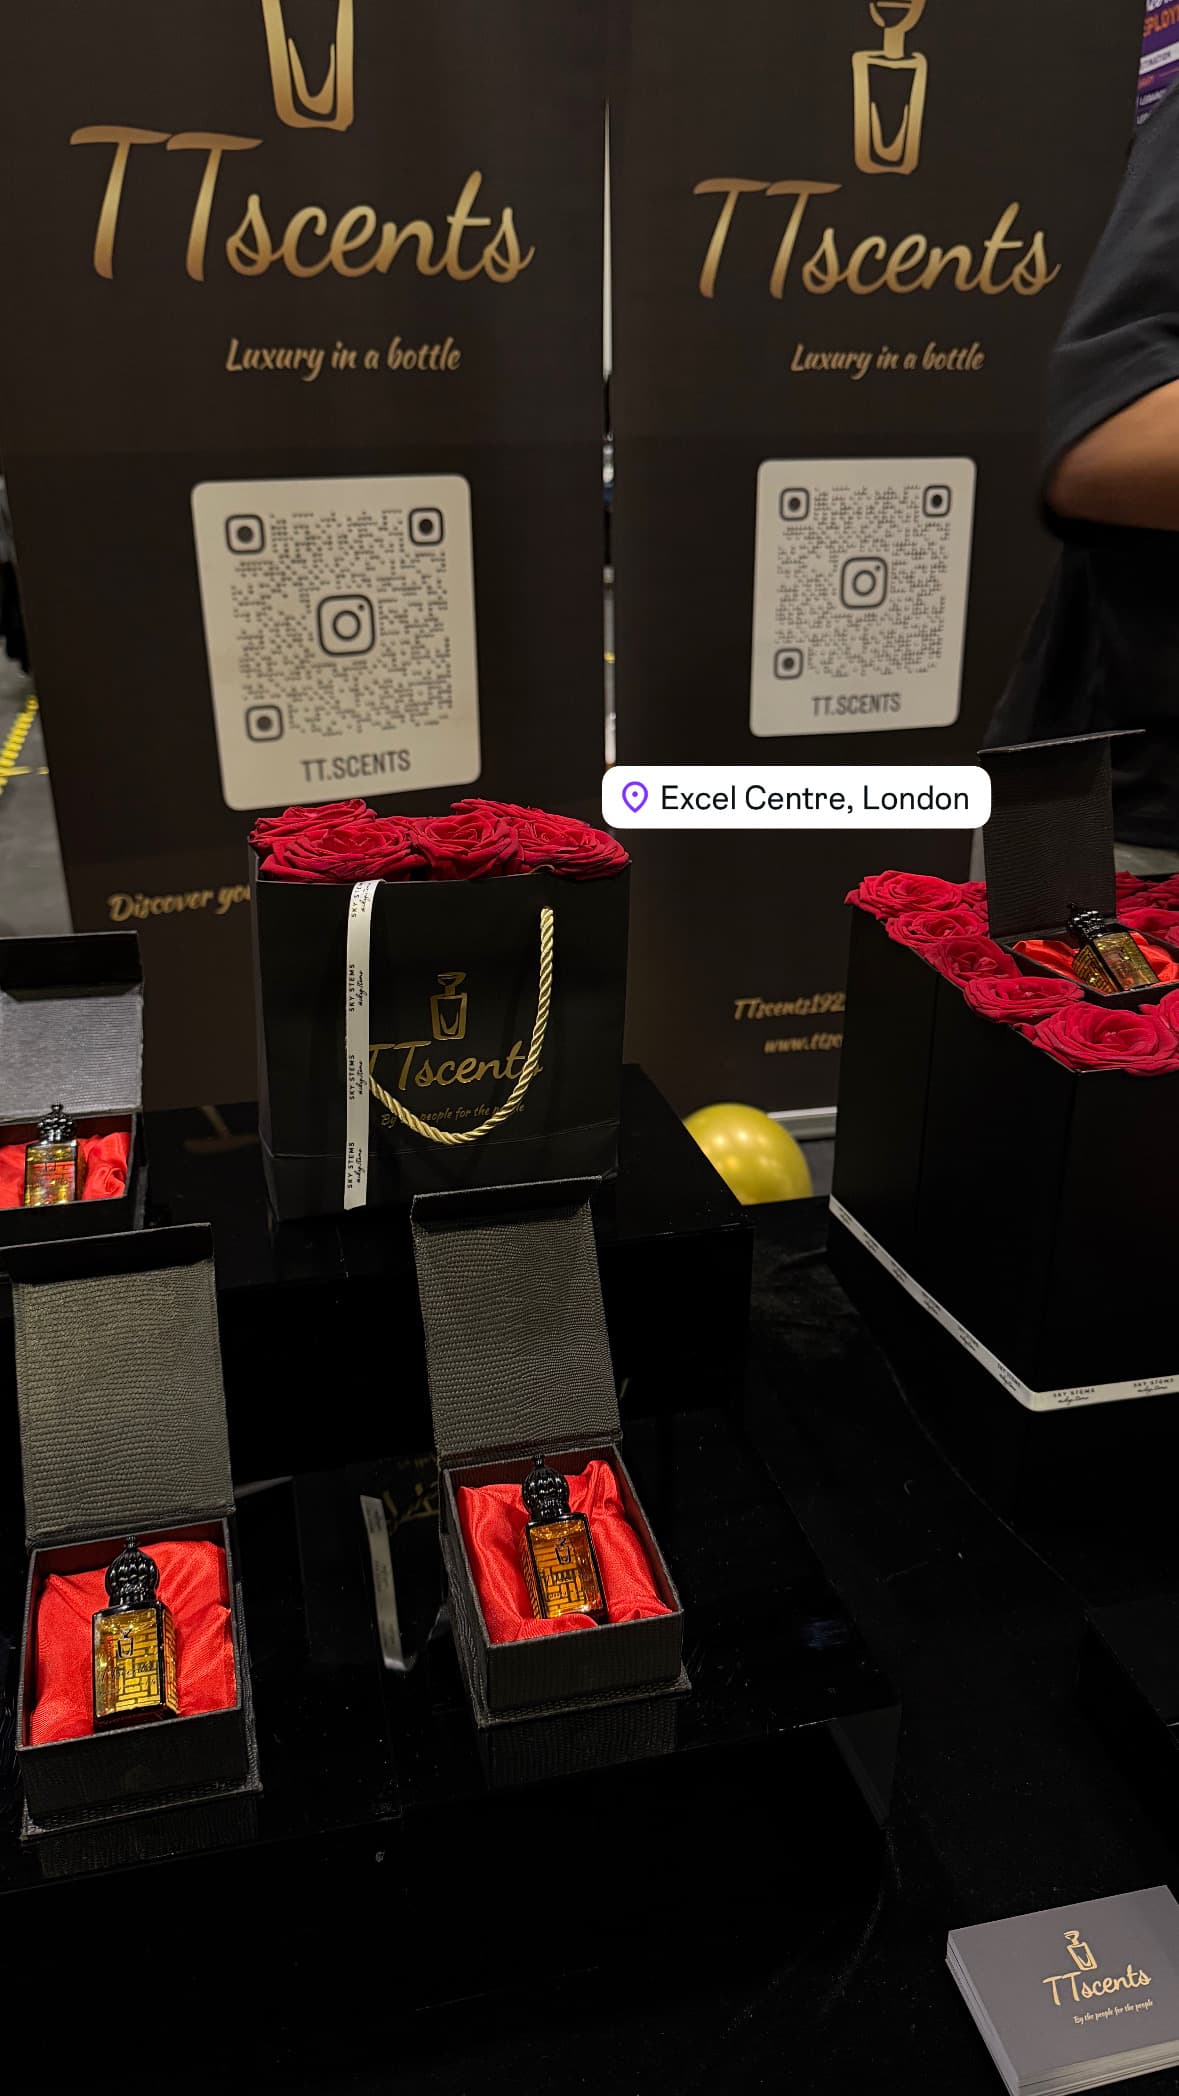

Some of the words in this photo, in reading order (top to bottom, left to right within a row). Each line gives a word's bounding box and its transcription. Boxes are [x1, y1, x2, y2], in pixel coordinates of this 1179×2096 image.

[69, 125, 536, 283] TTscents
[693, 177, 1062, 299] TTscents
[225, 337, 325, 382] Luxury
[331, 340, 356, 370] in
[363, 348, 381, 370] a
[386, 336, 461, 371] bottle
[790, 343, 874, 381] Luxury
[876, 345, 900, 370] in
[903, 351, 918, 370] a
[922, 341, 985, 371] bottle
[811, 692, 902, 717] TT.SCENTS
[300, 749, 411, 783] TT.SCENTS
[108, 892, 214, 922] Discover
[348, 964, 356, 993] STEMS
[348, 995, 356, 1012] SKY
[348, 1054, 356, 1082] STEMS
[369, 1040, 544, 1092] TTscent
[348, 1085, 356, 1101] SKY
[455, 1106, 472, 1121] for
[473, 1103, 490, 1117] the
[347, 1141, 355, 1170] STEMS
[346, 1172, 354, 1189] SKY
[1042, 1963, 1152, 2006] TTscents
[1095, 2007, 1114, 2021] people
[1114, 2006, 1124, 2016] for
[1124, 2003, 1135, 2013] the
[1135, 1998, 1153, 2012] people
